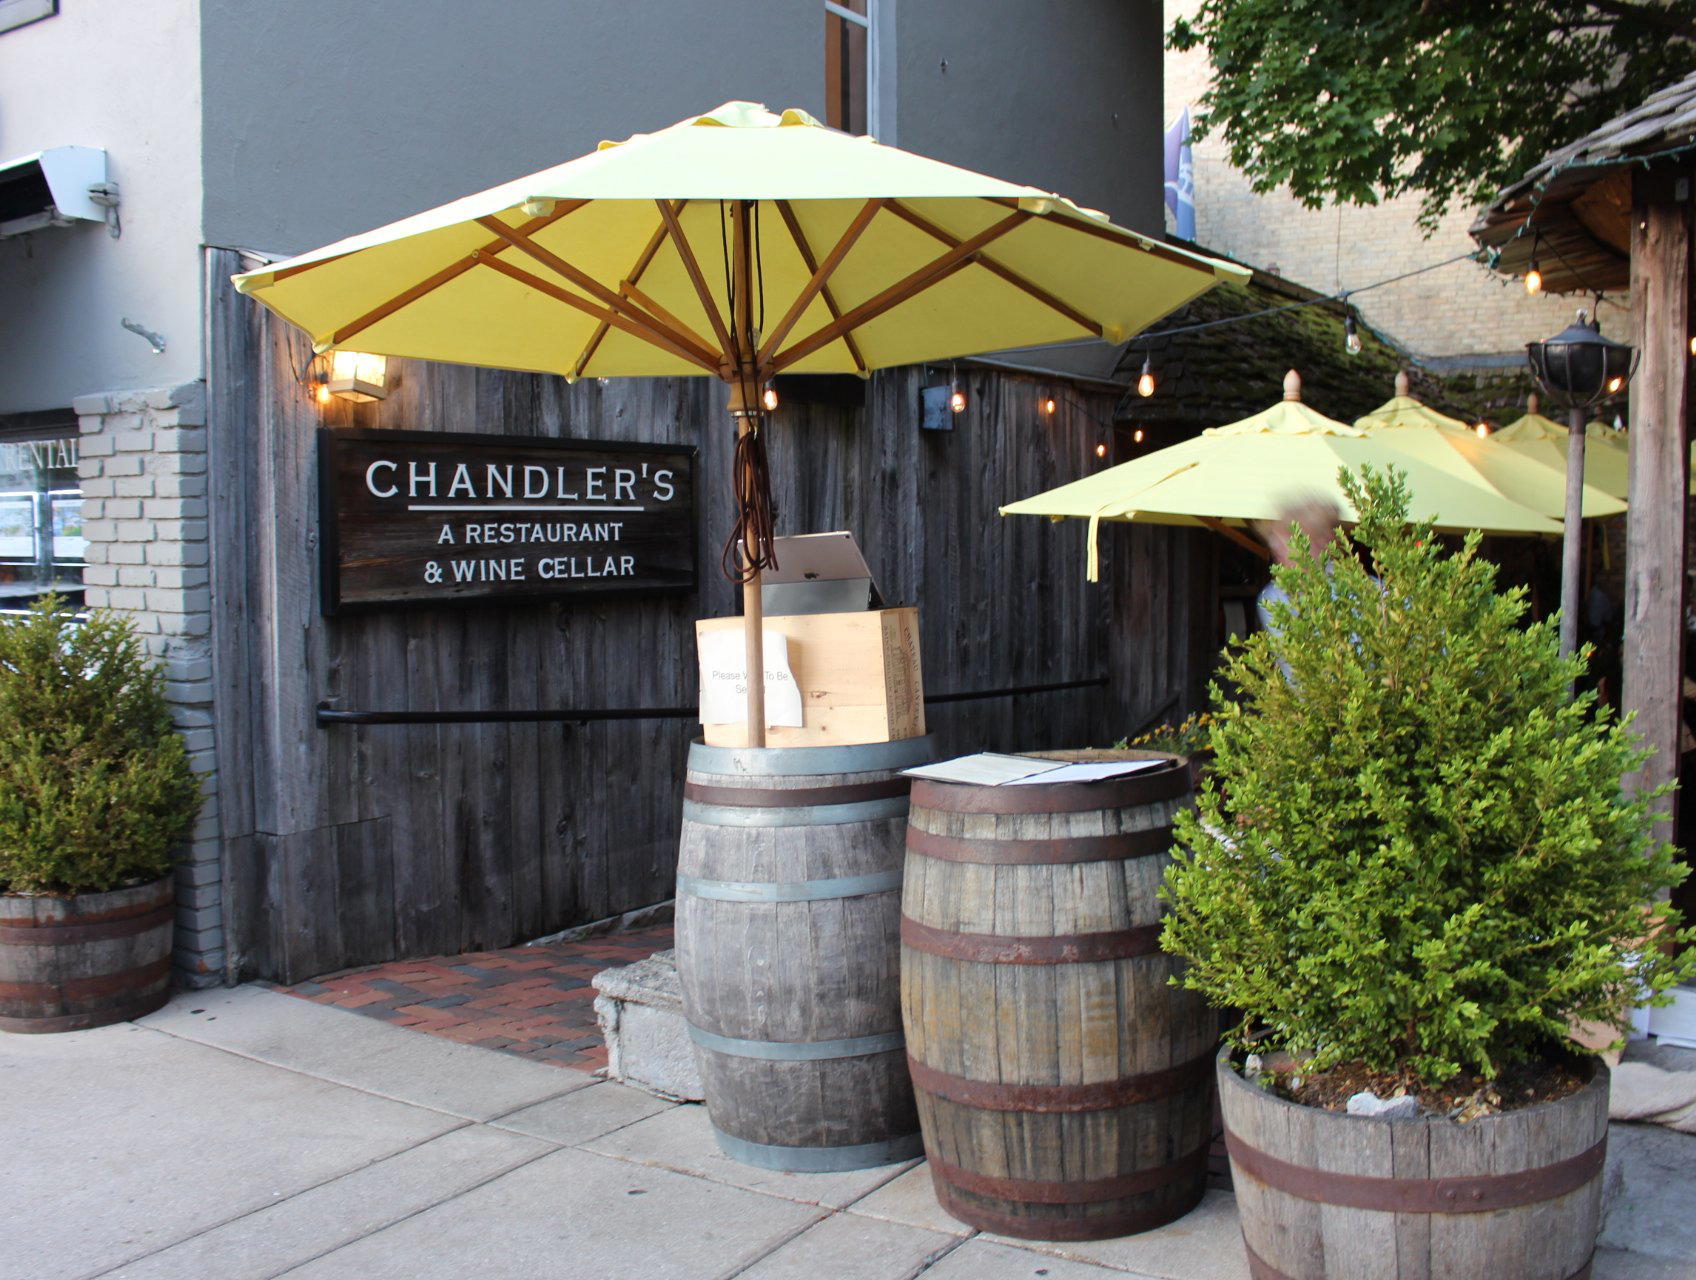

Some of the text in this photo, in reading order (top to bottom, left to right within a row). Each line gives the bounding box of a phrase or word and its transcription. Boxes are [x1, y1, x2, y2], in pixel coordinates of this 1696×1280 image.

[365, 460, 675, 502] CHANDLER'S
[437, 522, 624, 545] A RESTAURANT
[424, 555, 635, 584] & WINE CELLAR
[712, 671, 740, 680] Please
[765, 671, 775, 680] To
[777, 671, 788, 680] Be
